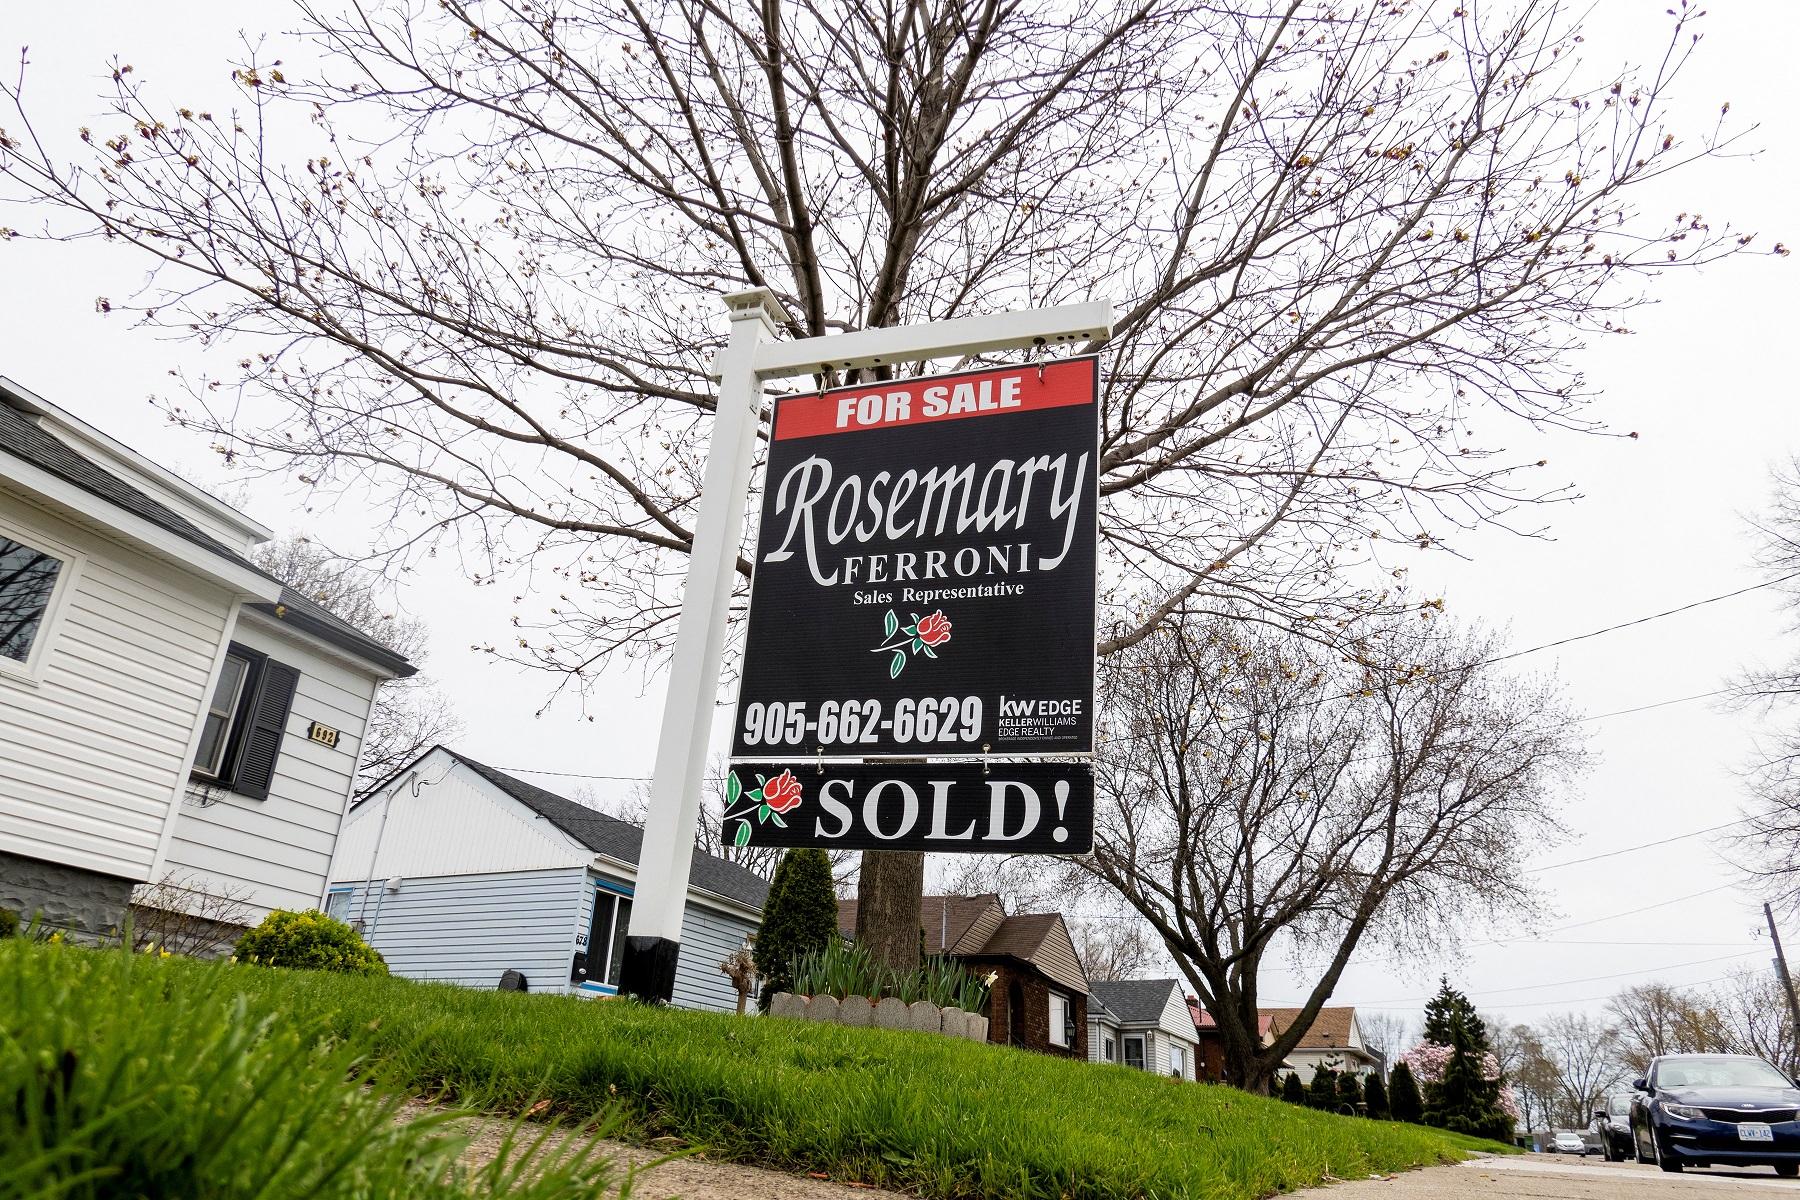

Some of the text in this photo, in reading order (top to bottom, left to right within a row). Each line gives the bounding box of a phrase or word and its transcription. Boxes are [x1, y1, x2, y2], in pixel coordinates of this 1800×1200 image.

[836, 376, 1022, 429] FOR SALE
[763, 450, 1089, 587] Rosemary
[841, 543, 1032, 585] FERRONI
[853, 581, 1025, 605] Sales Representative
[743, 695, 983, 746] 905-662-6629
[1038, 699, 1082, 715] EDGE
[316, 727, 334, 742] 692
[998, 727, 1055, 736] EDGE REALTY
[814, 779, 1070, 843] SOLD!
